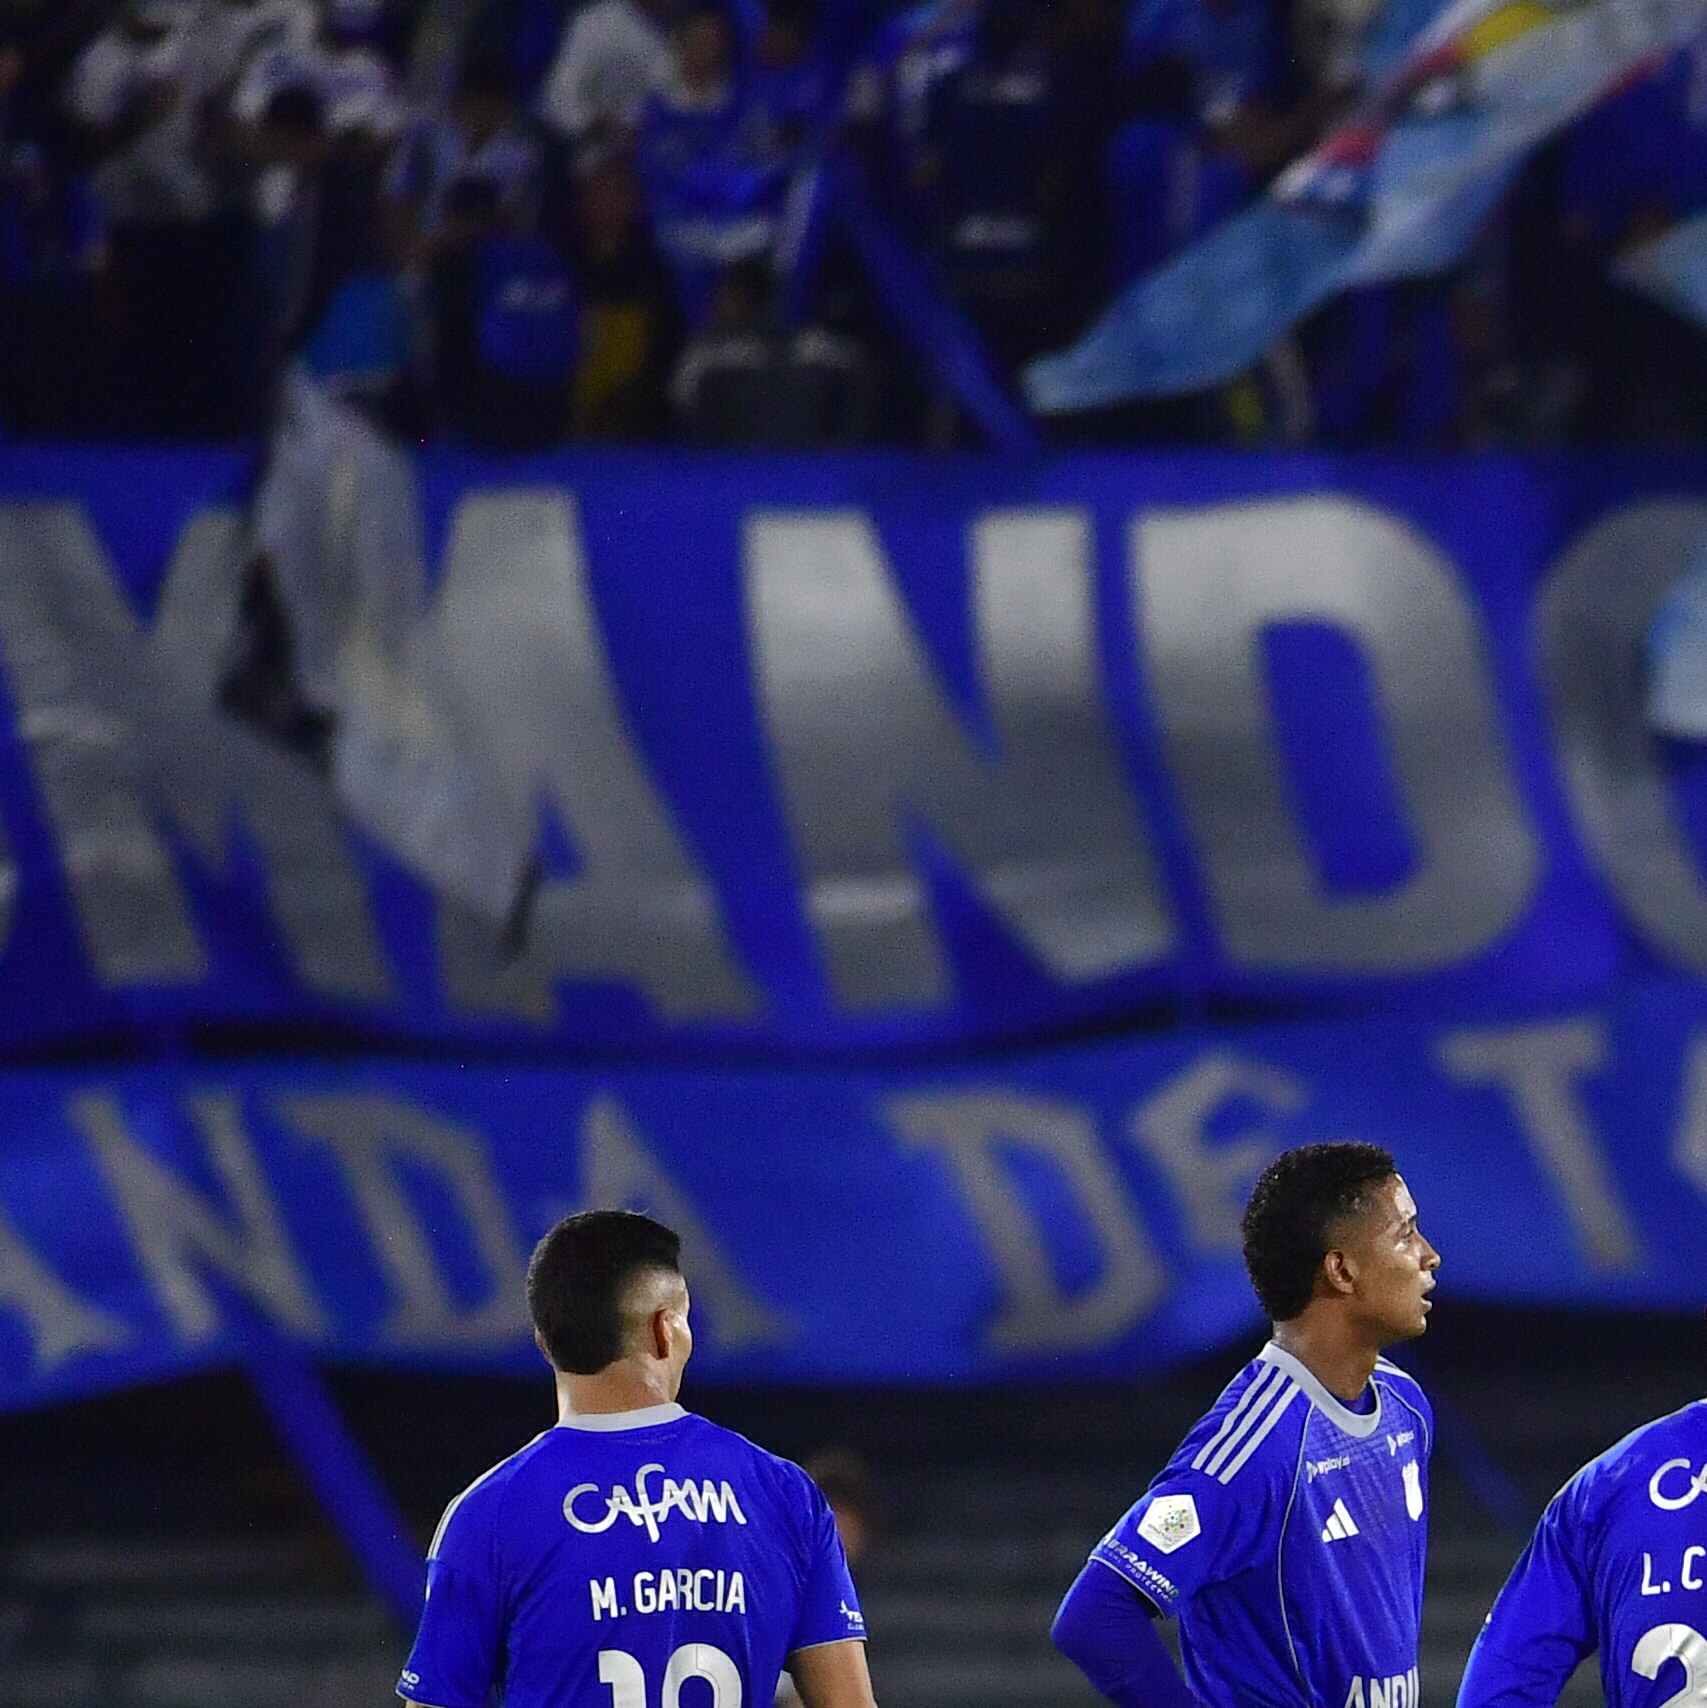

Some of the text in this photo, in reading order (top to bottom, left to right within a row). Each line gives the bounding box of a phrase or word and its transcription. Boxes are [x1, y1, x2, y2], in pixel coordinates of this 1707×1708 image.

[588, 1568, 747, 1621] M. GARCIA
[1641, 1551, 1672, 1597] L.
